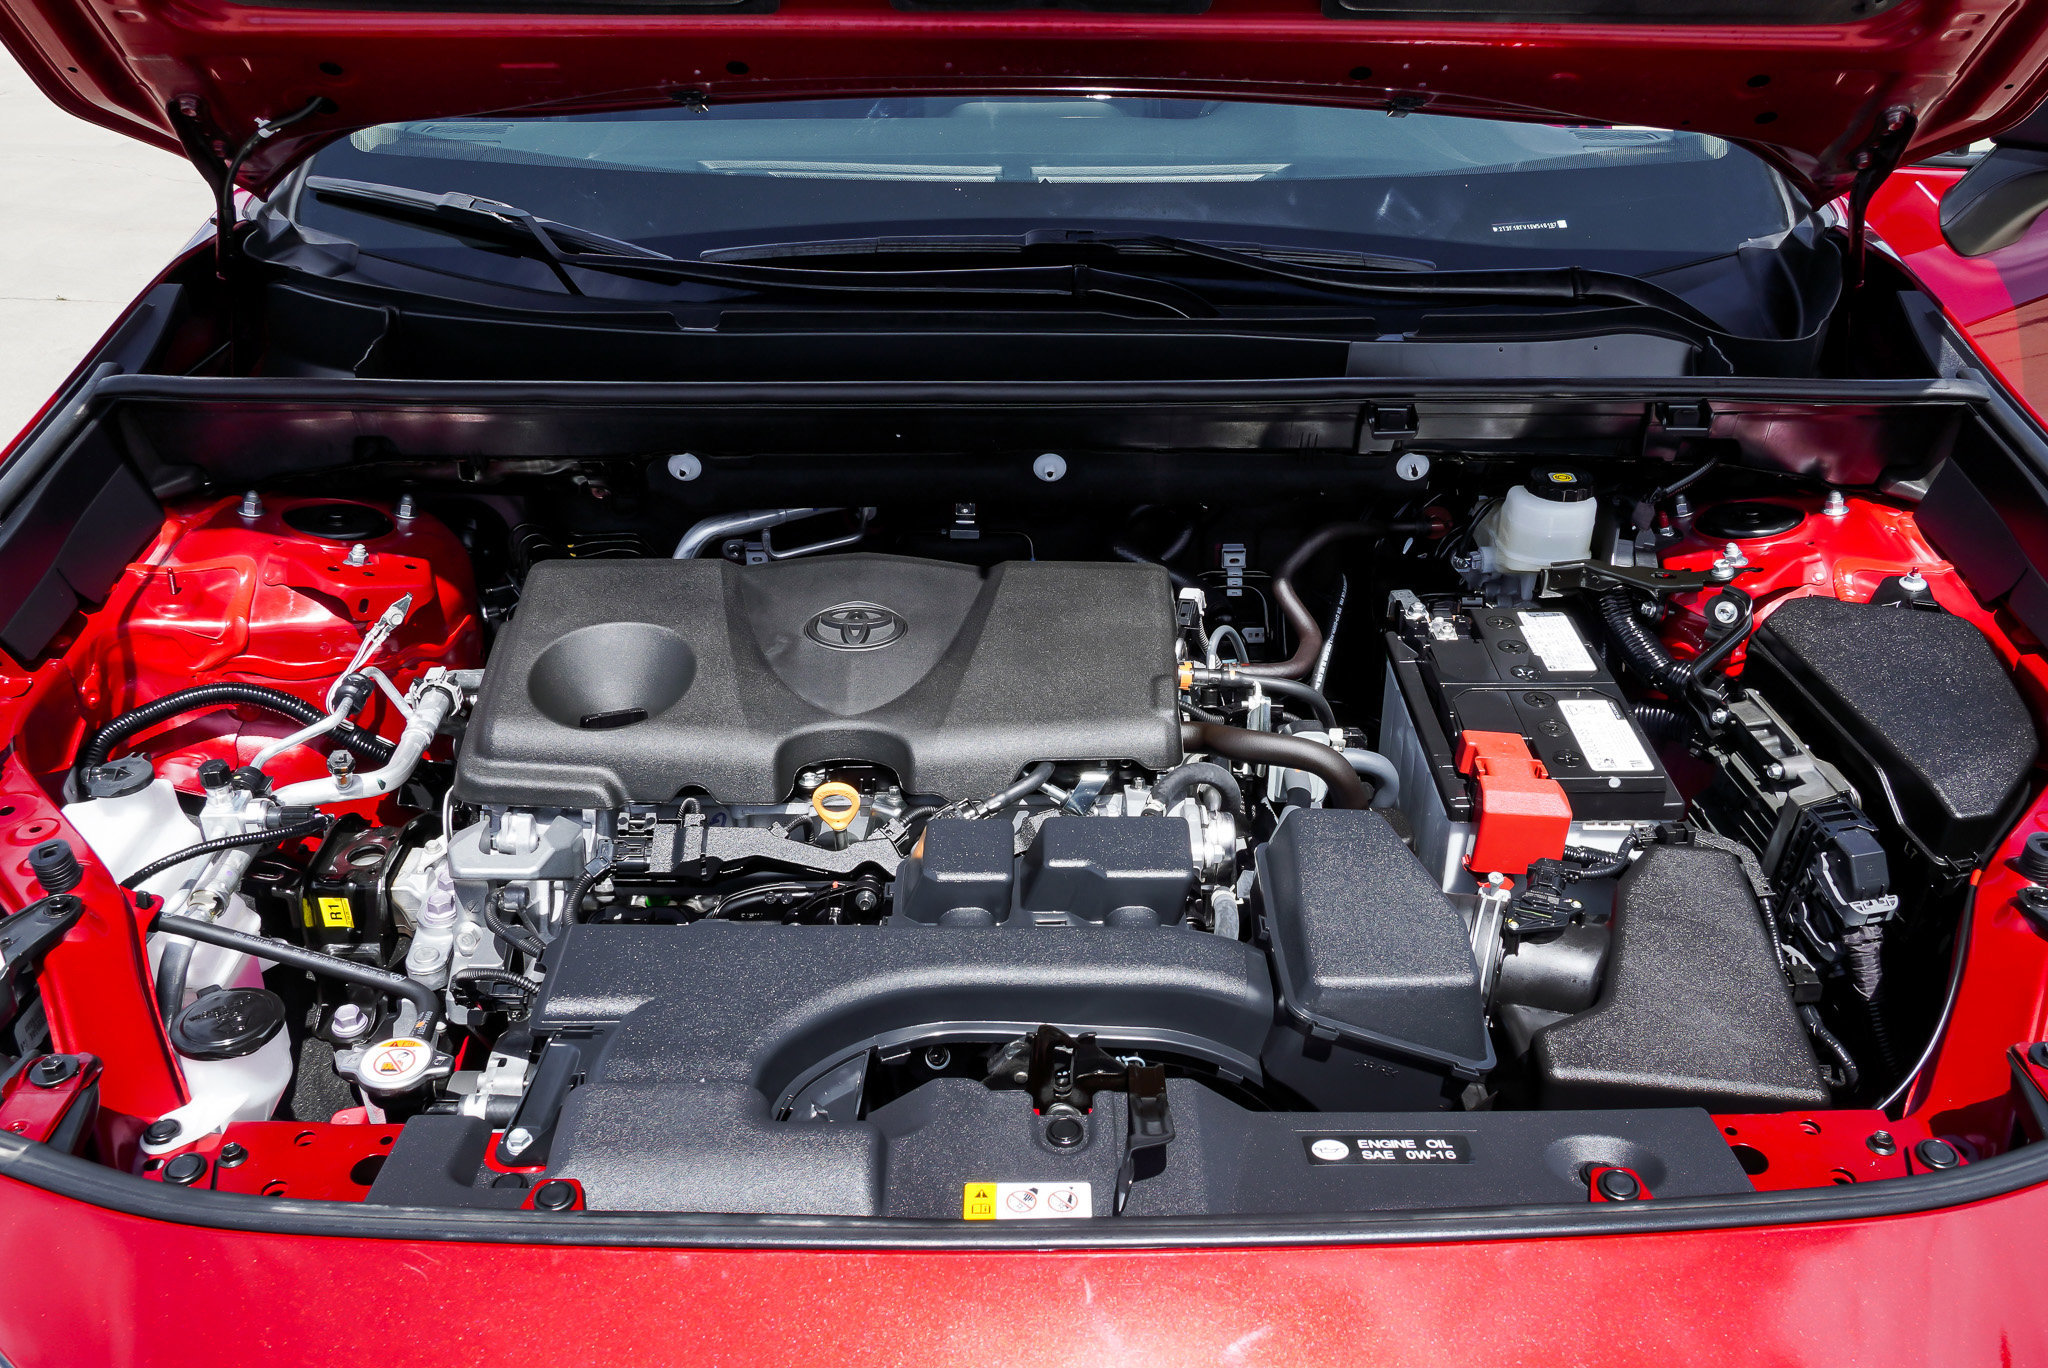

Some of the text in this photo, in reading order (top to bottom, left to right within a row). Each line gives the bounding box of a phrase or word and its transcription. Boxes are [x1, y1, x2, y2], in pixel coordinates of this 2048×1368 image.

[328, 904, 342, 920] R1
[1357, 1139, 1453, 1149] ENGINE OIL
[1362, 1150, 1457, 1160] SAE 0W-16
